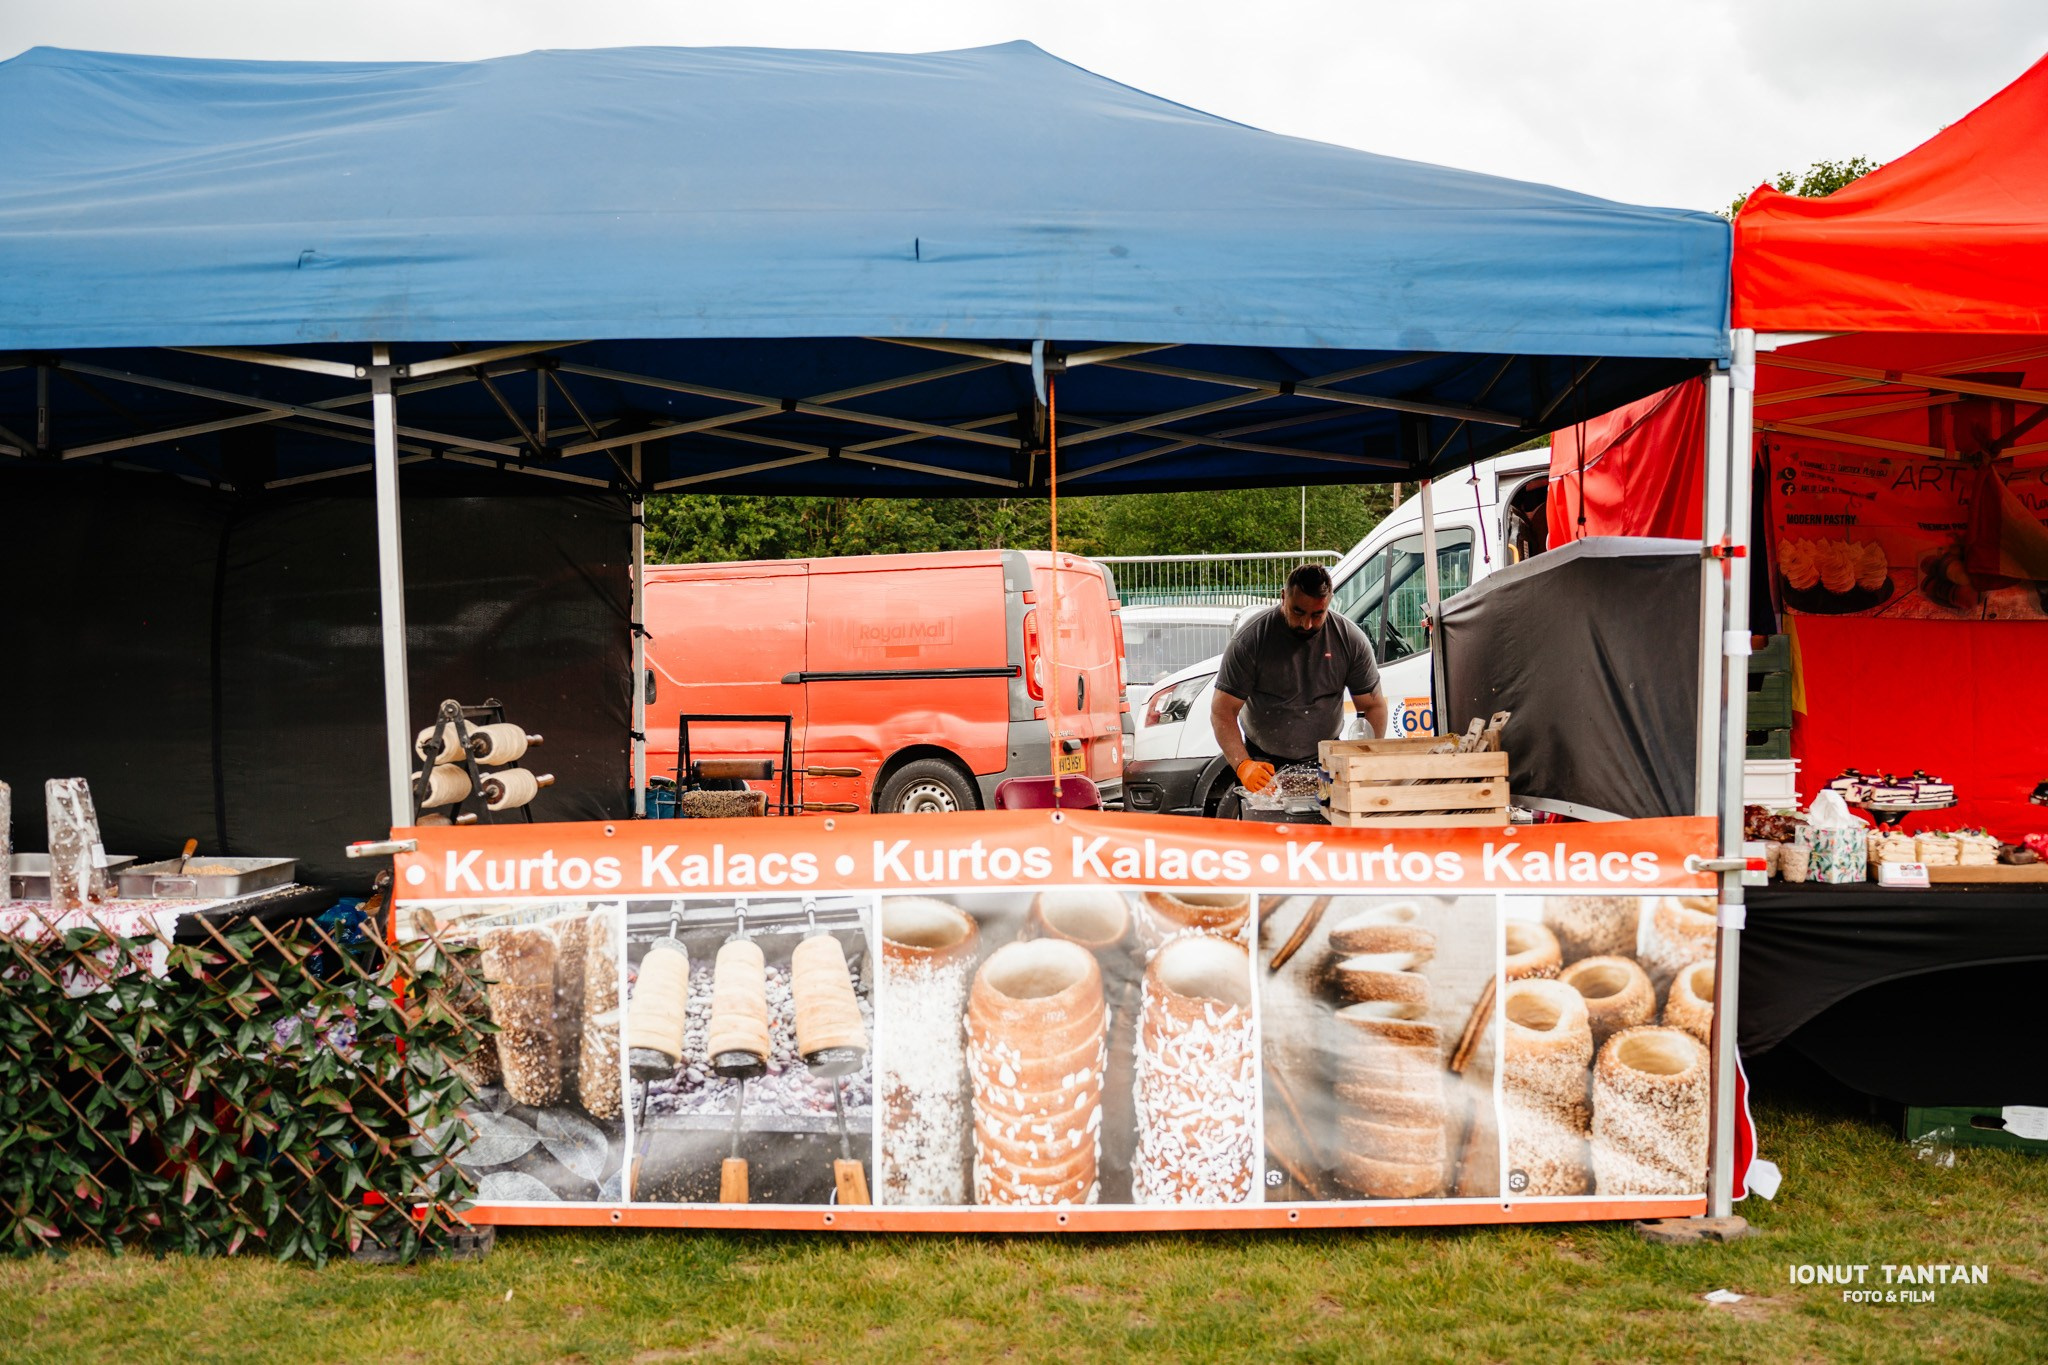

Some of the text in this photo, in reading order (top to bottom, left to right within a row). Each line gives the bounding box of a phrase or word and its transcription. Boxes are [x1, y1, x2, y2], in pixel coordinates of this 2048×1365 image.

[1891, 464, 1968, 491] ART
[1786, 513, 1857, 525] MODERN PASTRY
[1917, 521, 1950, 530] FRENCH
[860, 621, 945, 642] Royal Mail
[1402, 709, 1434, 732] 60
[443, 835, 1661, 892] Kurtos Kalacs Kurtos Kalacs Kurtos Kalacs
